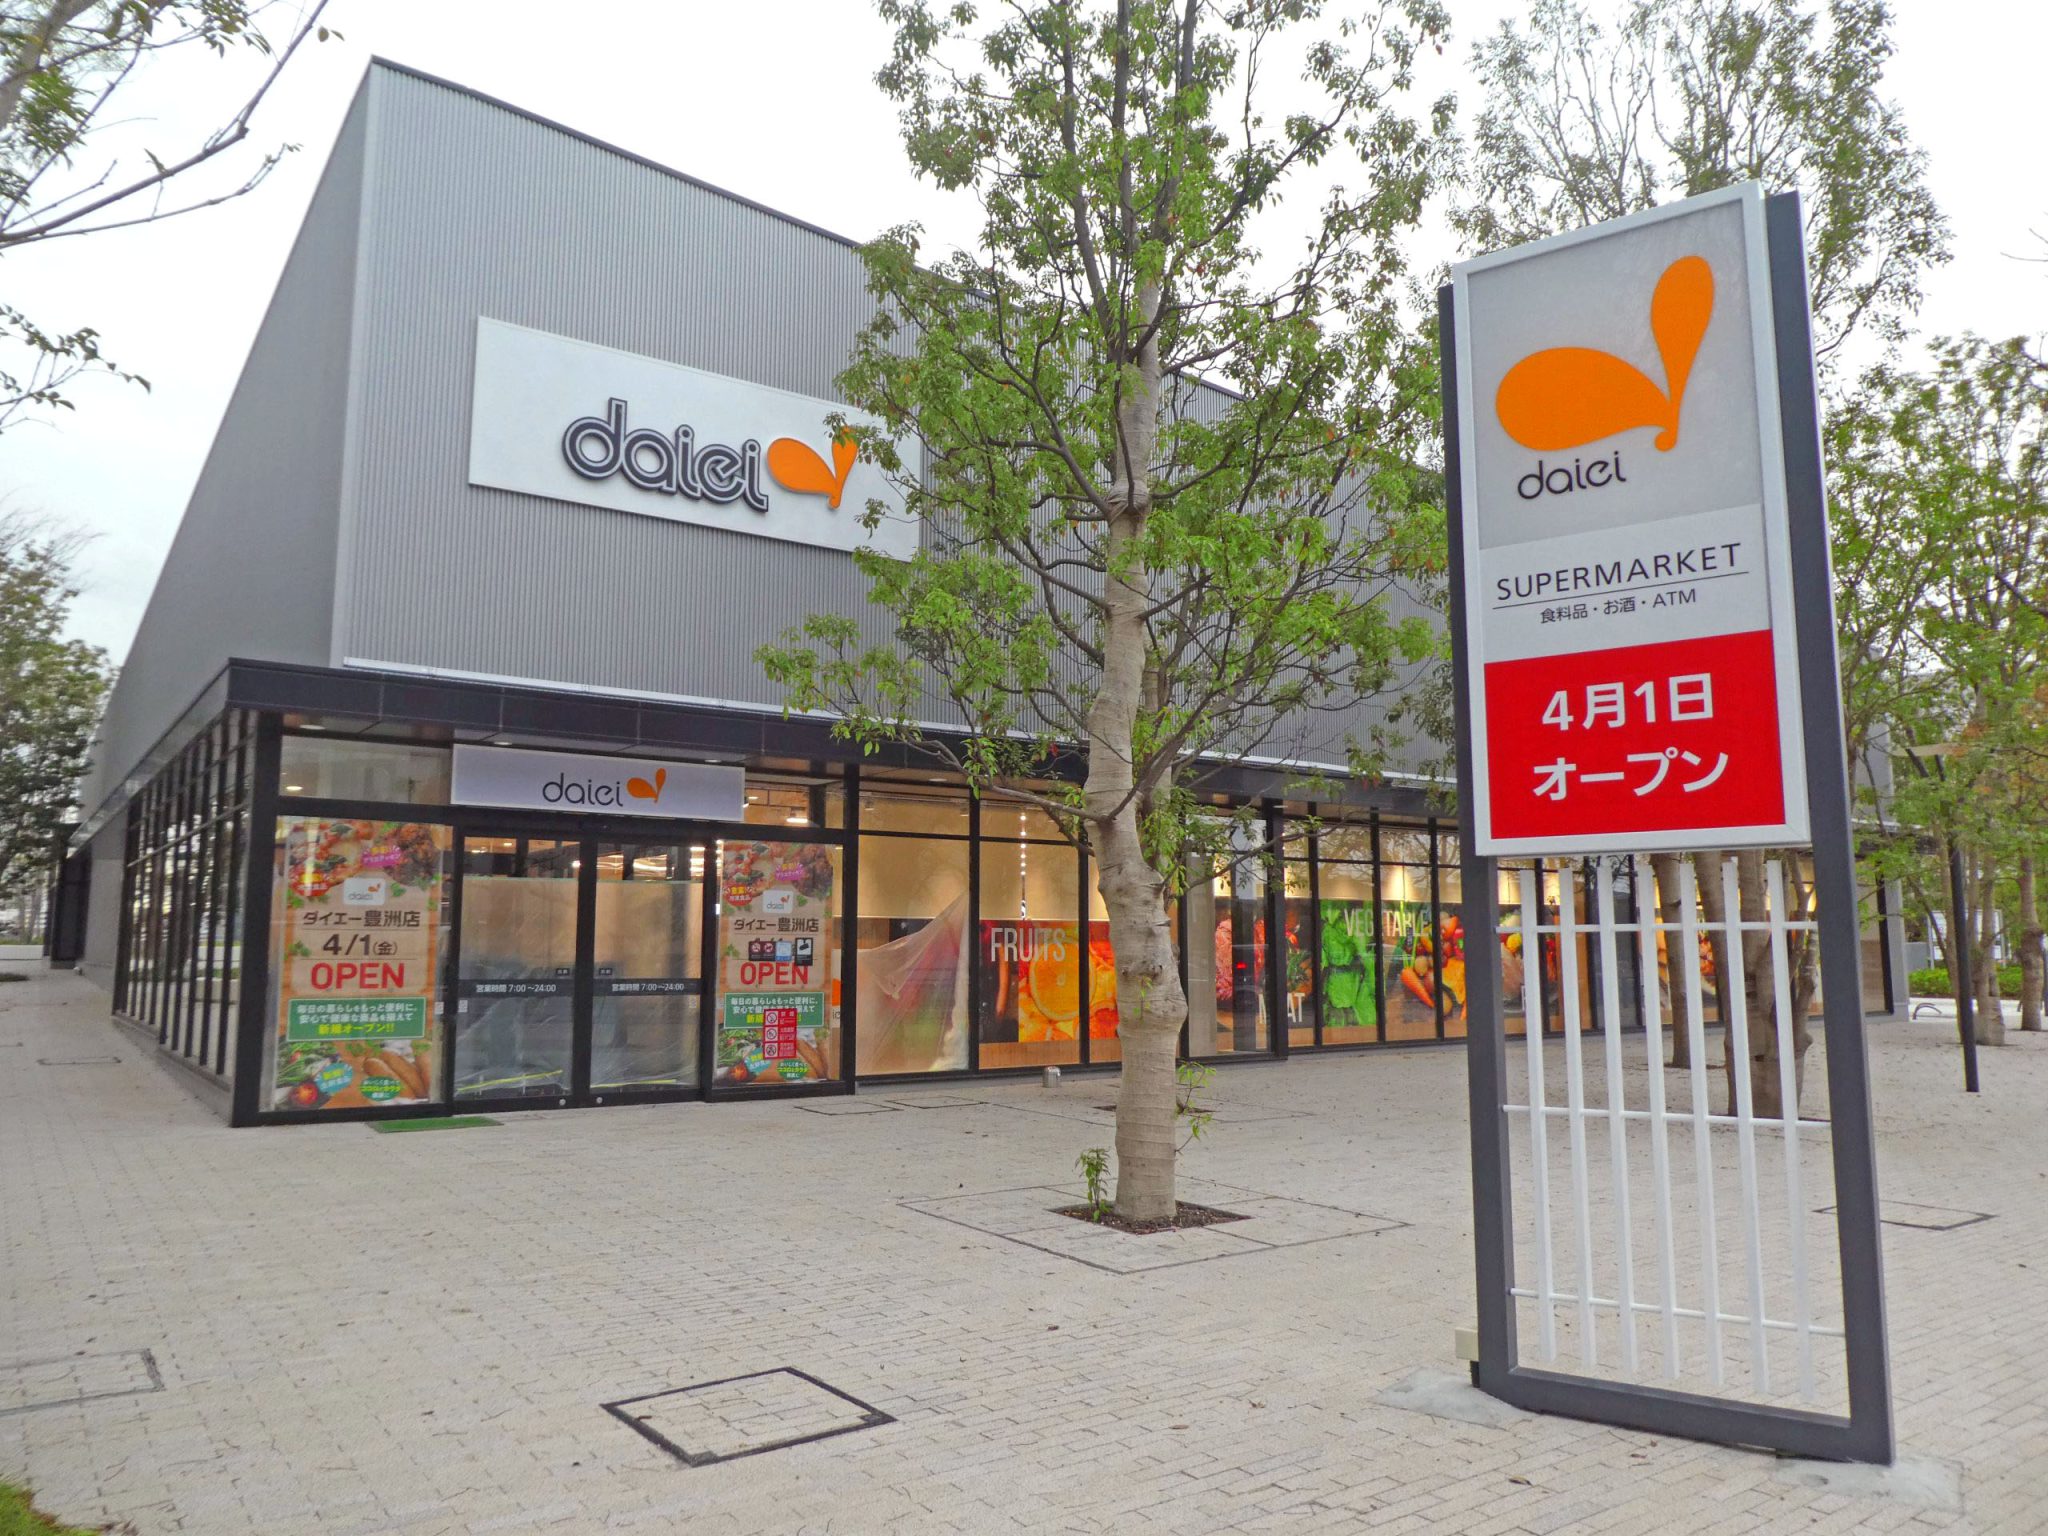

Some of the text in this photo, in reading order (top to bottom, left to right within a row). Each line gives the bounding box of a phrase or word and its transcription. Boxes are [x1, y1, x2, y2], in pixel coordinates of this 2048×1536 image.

[562, 397, 769, 513] daiei
[1517, 450, 1626, 500] daiei
[1497, 543, 1741, 600] SUPERMARKET
[1542, 672, 1714, 731] 4月1日
[542, 772, 623, 807] daiei
[1533, 746, 1729, 801] オープン
[303, 910, 421, 928] ダイエー豊洲店
[734, 917, 819, 932] ダイエー豊洲店
[1343, 908, 1433, 937] VEGTABLE
[991, 927, 1066, 962] FRUITS
[311, 962, 405, 990] OPEN
[740, 961, 809, 985] OPEN
[1258, 992, 1306, 1024] MAT
